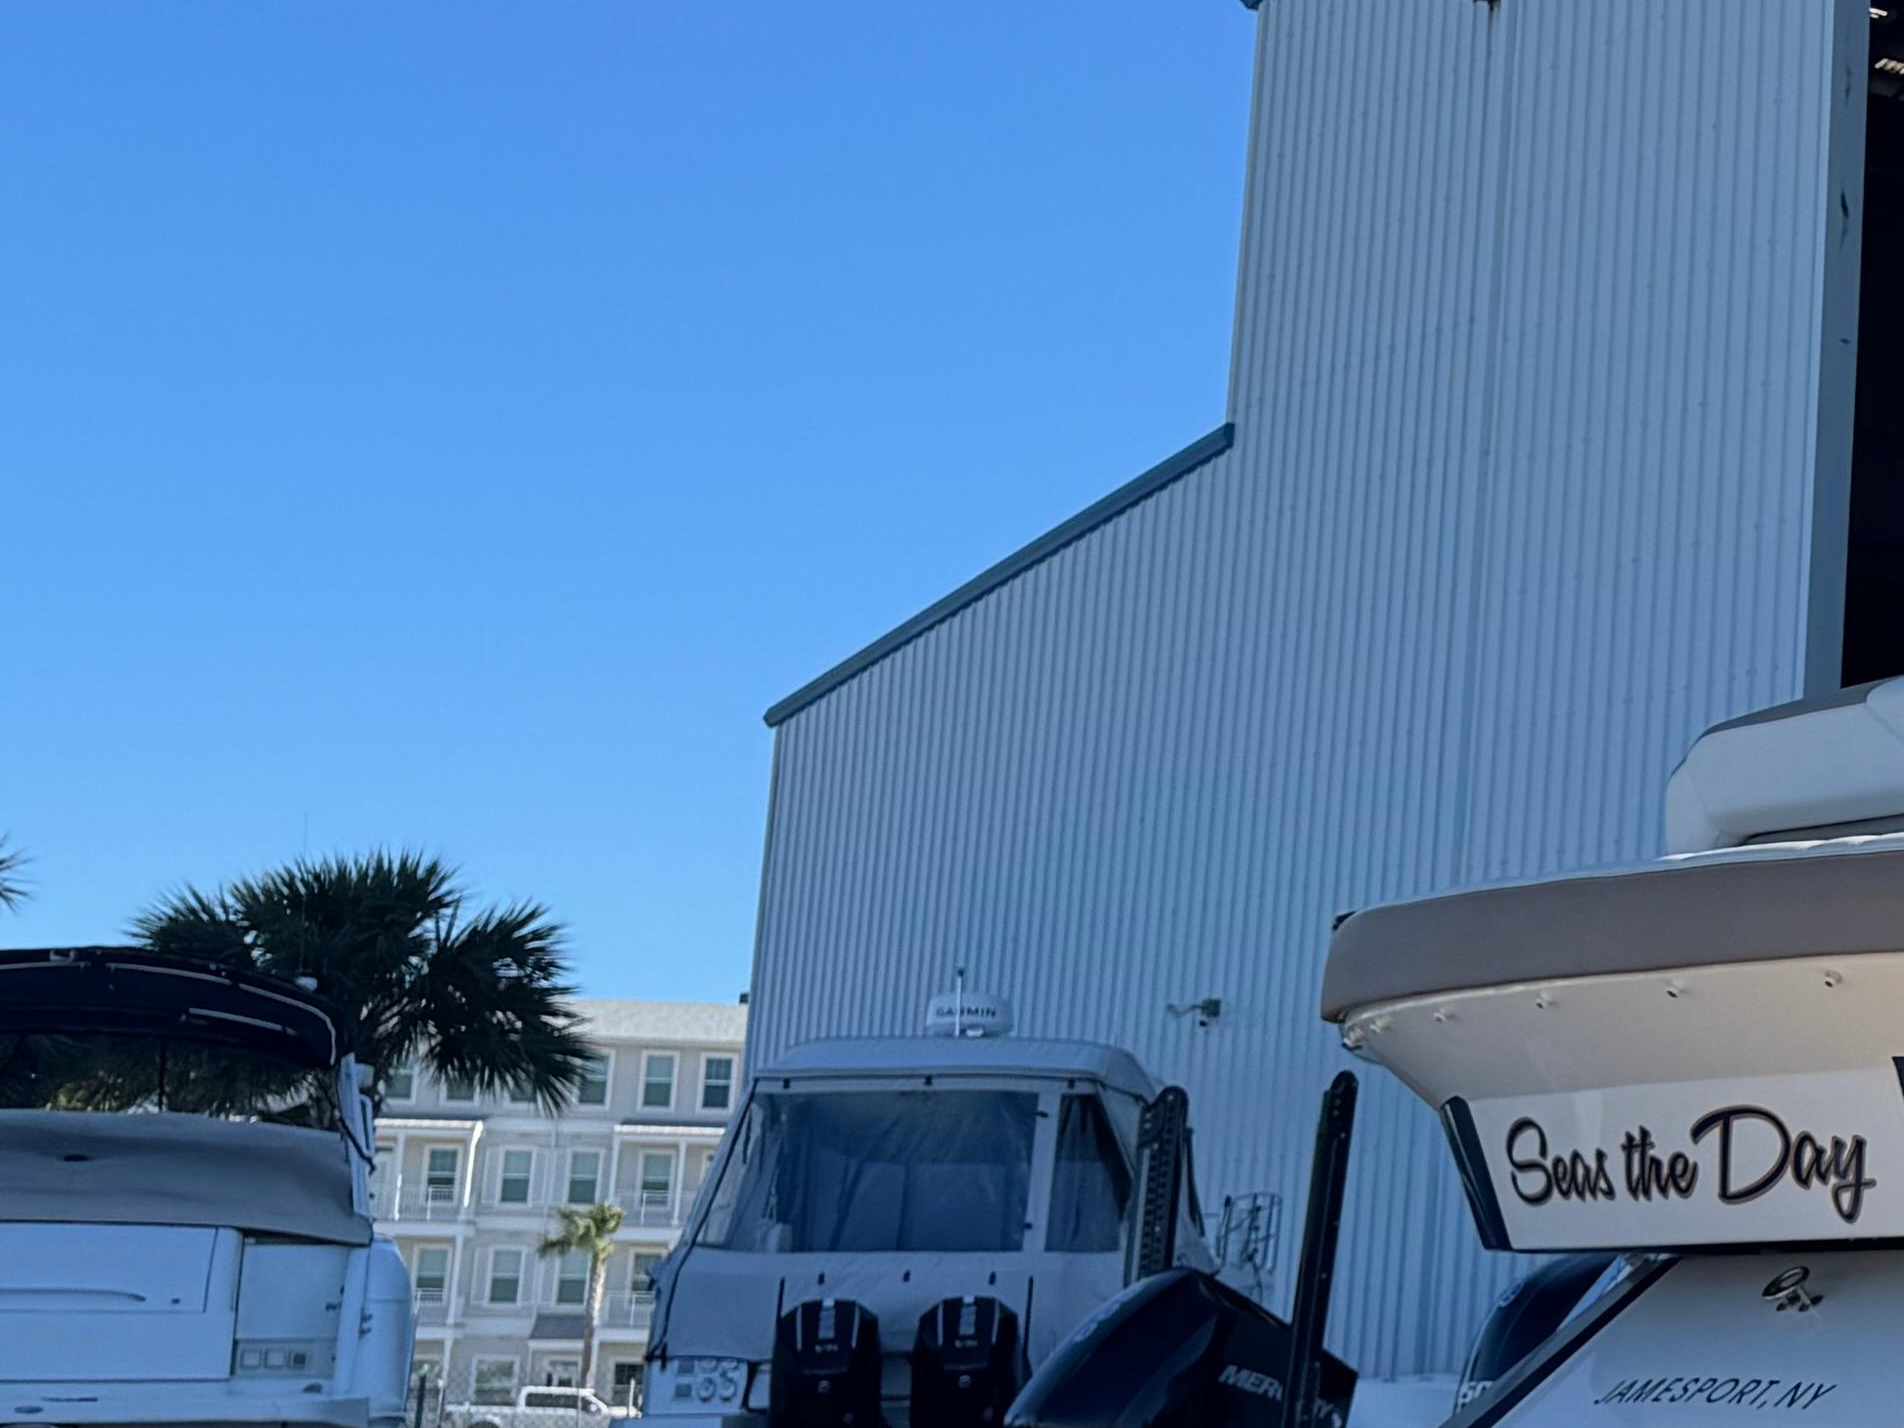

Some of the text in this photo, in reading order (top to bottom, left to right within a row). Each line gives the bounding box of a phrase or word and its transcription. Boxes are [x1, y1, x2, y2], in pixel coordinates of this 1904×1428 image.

[1505, 1104, 1877, 1224] Seas the Day
[1593, 1377, 1837, 1410] JAMESPORT, NY
